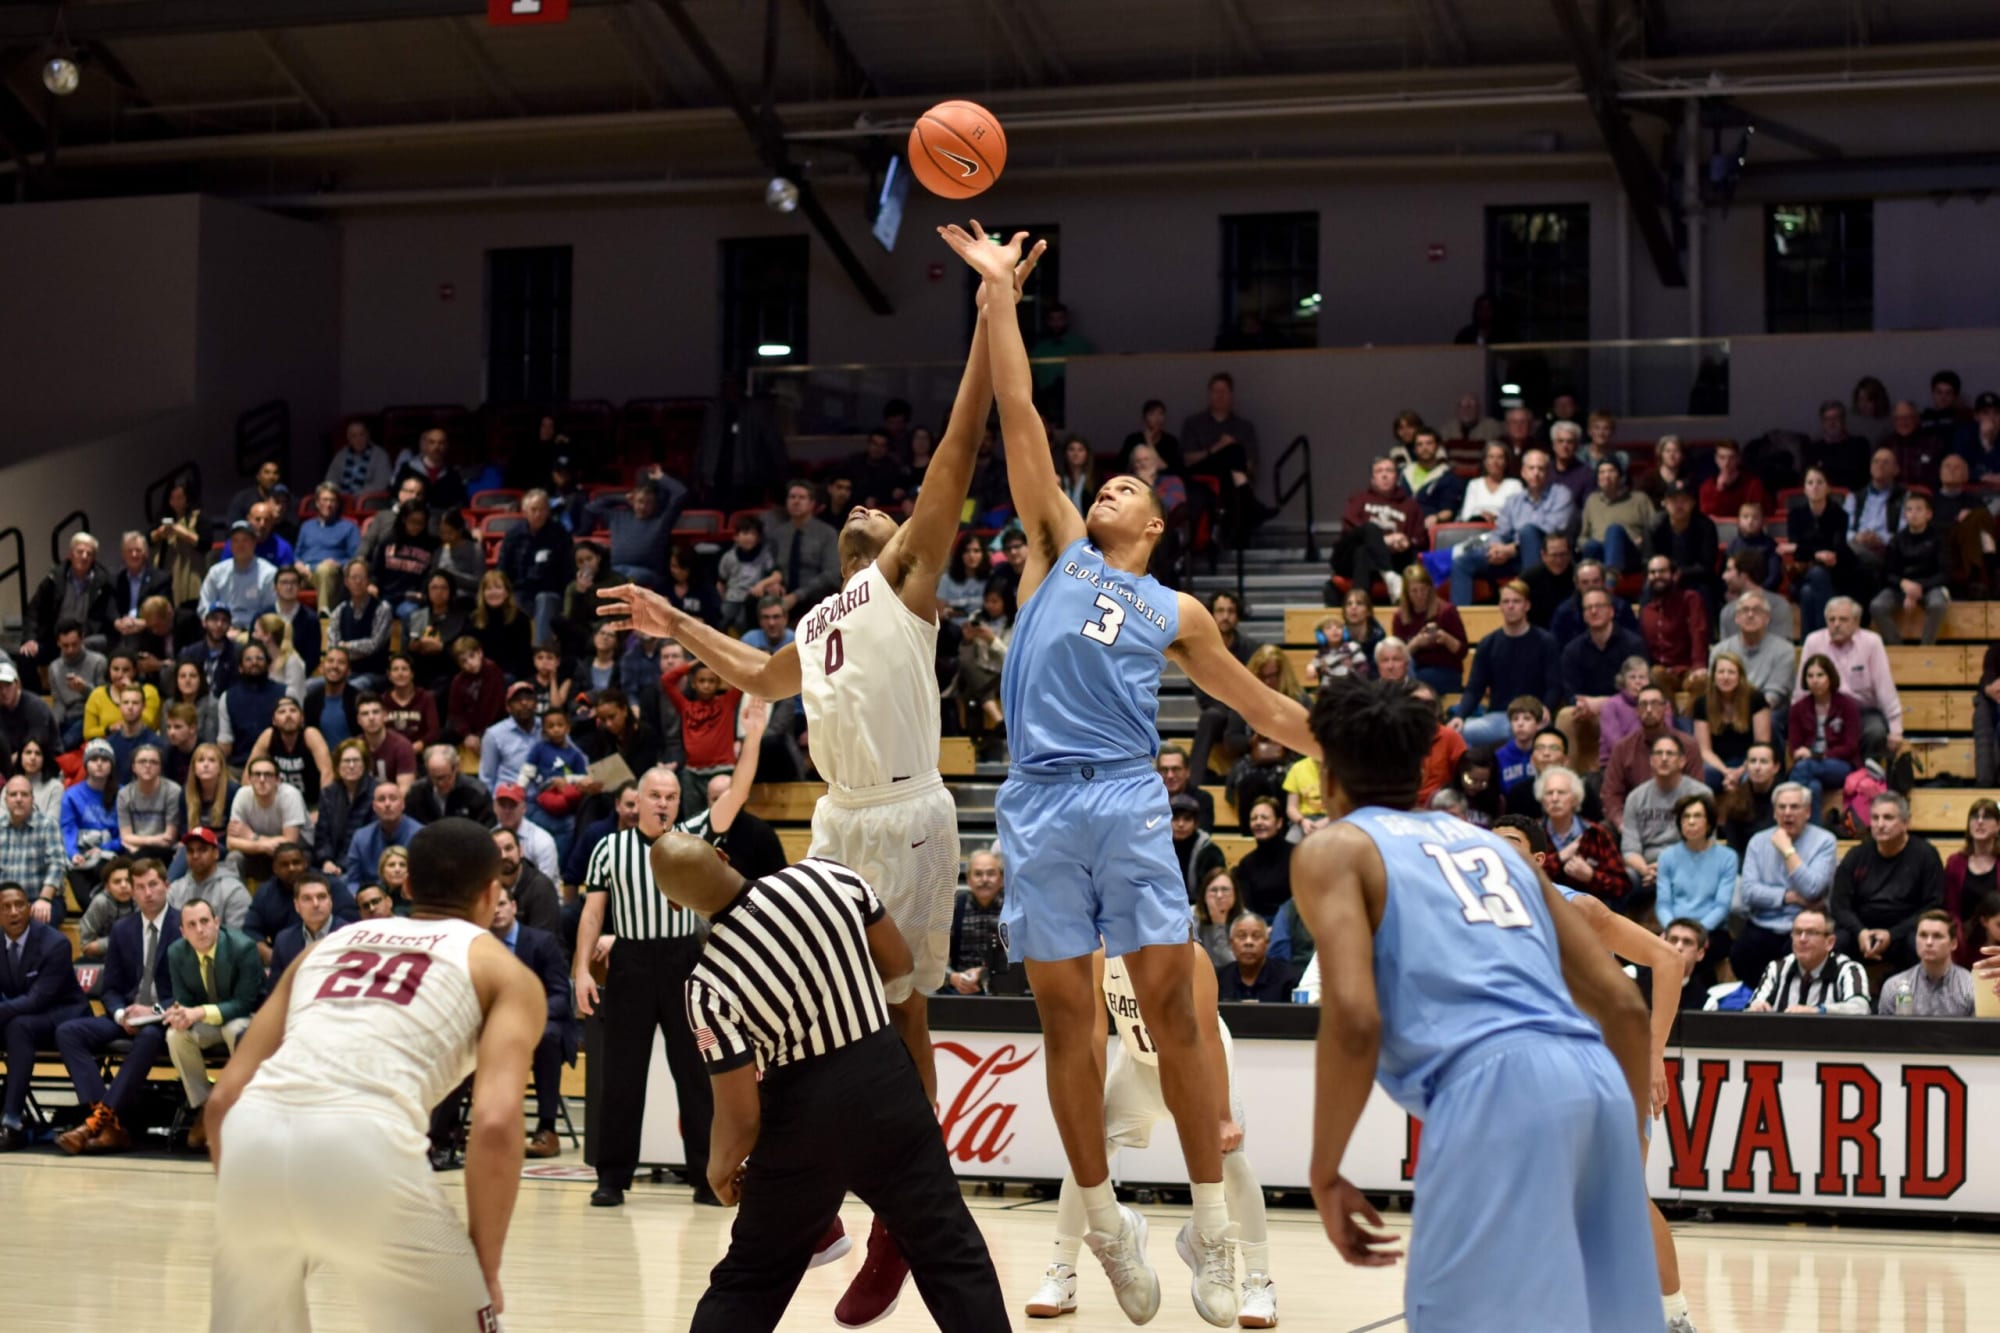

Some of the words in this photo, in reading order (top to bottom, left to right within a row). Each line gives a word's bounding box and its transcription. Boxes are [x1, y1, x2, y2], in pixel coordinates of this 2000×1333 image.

[972, 126, 986, 140] H
[805, 581, 870, 645] HARVARD
[1064, 561, 1168, 632] COLUMBIA
[1080, 592, 1126, 647] 3
[825, 628, 844, 676] 0
[1420, 844, 1533, 928] 13
[314, 950, 433, 1006] 20
[1660, 1057, 1968, 1200] VARD
